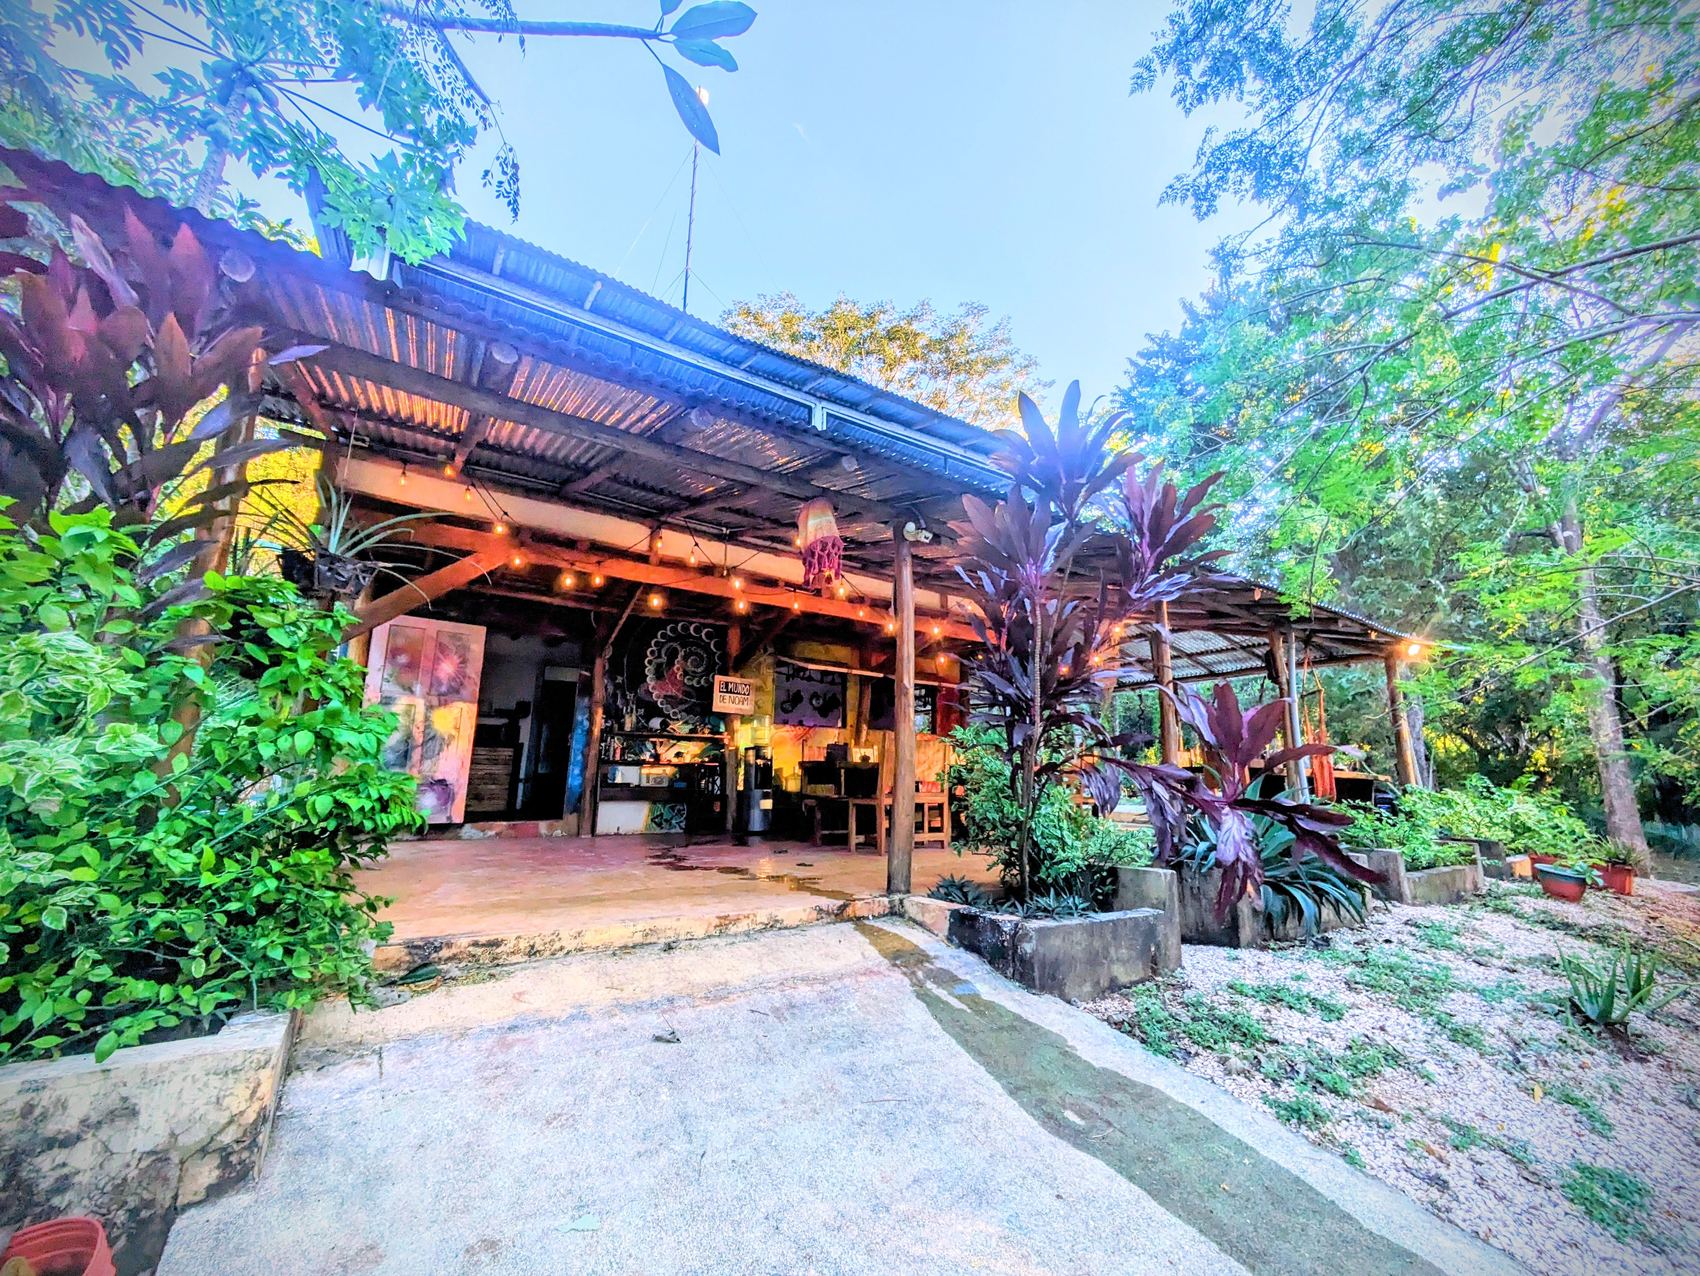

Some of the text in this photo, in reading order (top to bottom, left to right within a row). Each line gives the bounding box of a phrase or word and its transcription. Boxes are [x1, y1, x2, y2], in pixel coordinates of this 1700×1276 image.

[720, 681, 750, 695] EL MUNDO
[719, 694, 749, 706] DE NOAM
